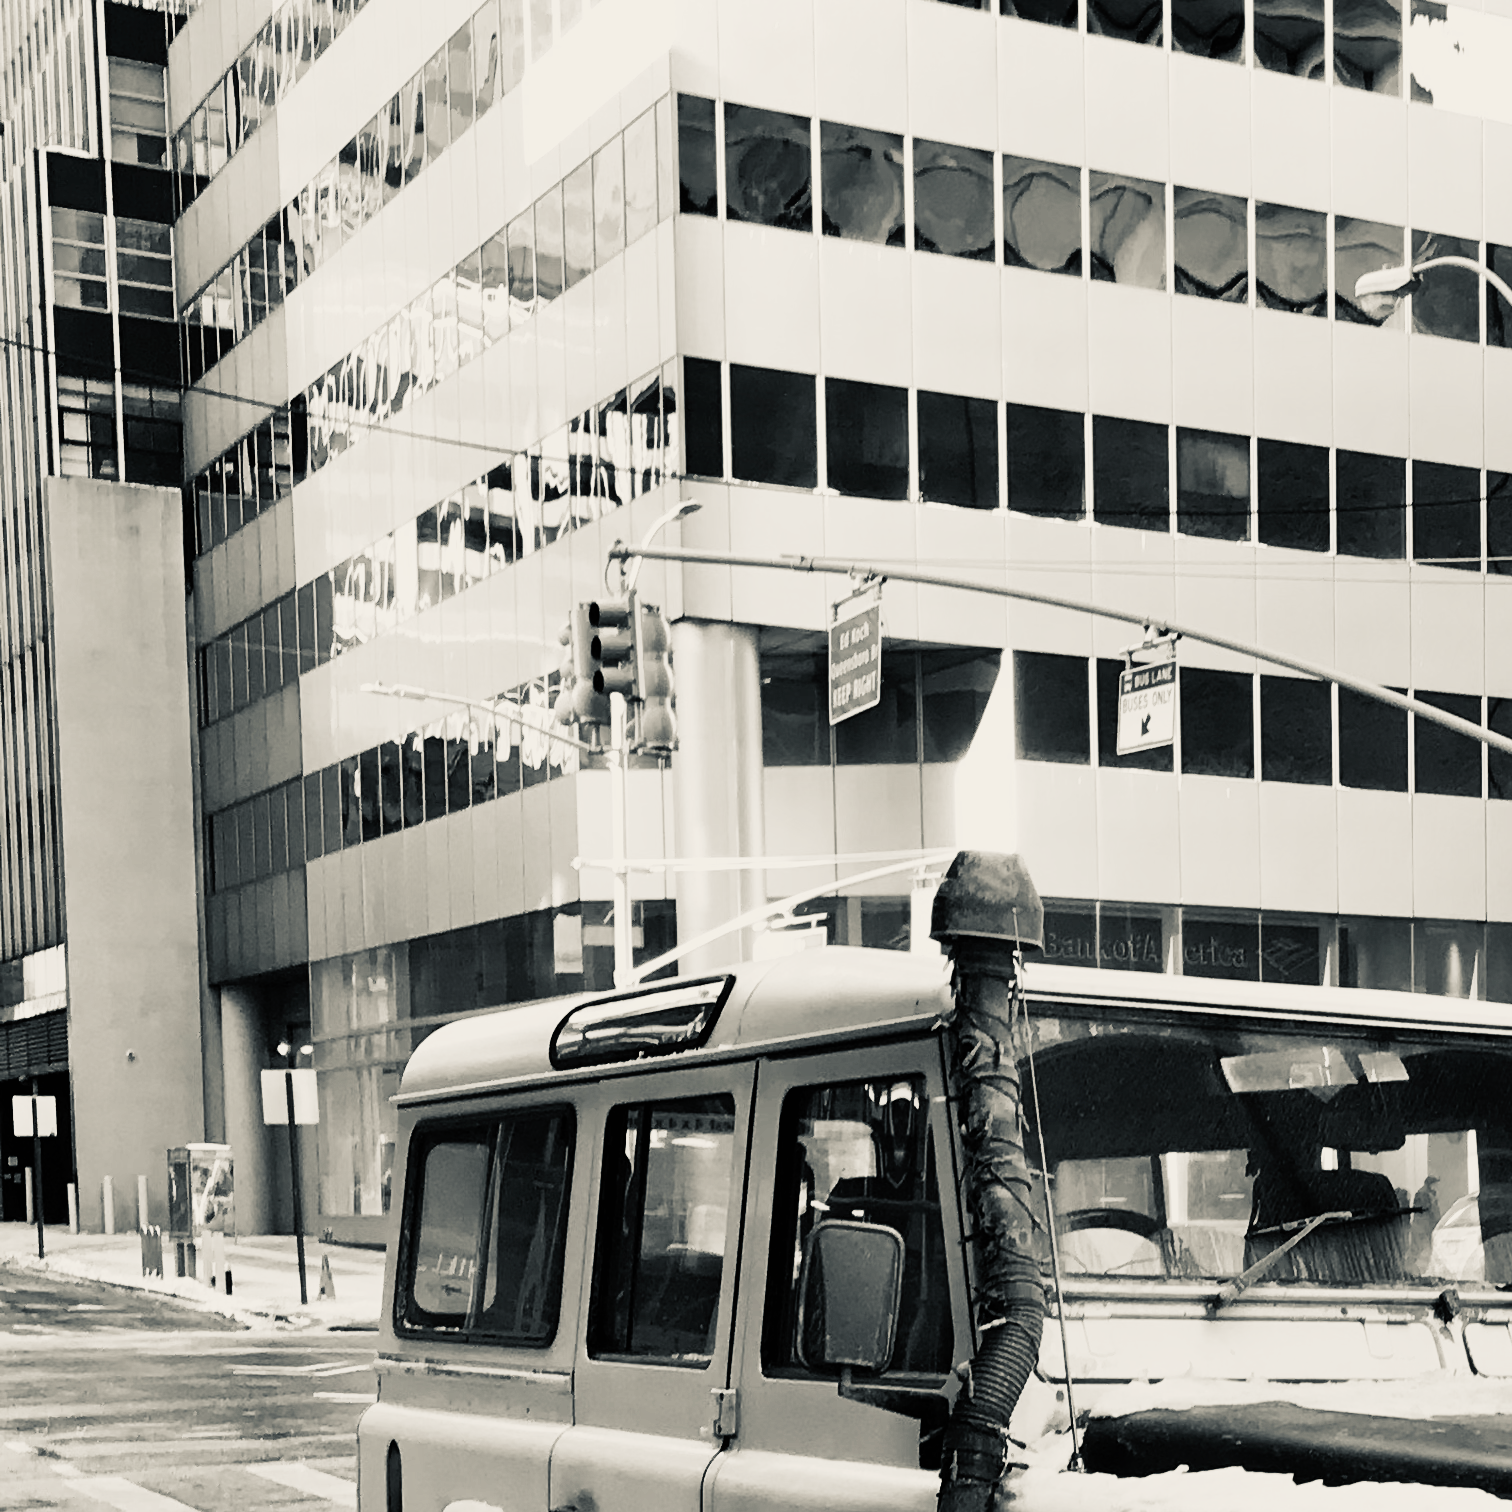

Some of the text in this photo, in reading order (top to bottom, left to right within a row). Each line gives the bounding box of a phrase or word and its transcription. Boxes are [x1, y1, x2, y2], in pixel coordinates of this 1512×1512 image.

[853, 670, 876, 700] RIGHT
[1151, 666, 1173, 685] LANE
[1122, 688, 1173, 714] BUSES ONLY
